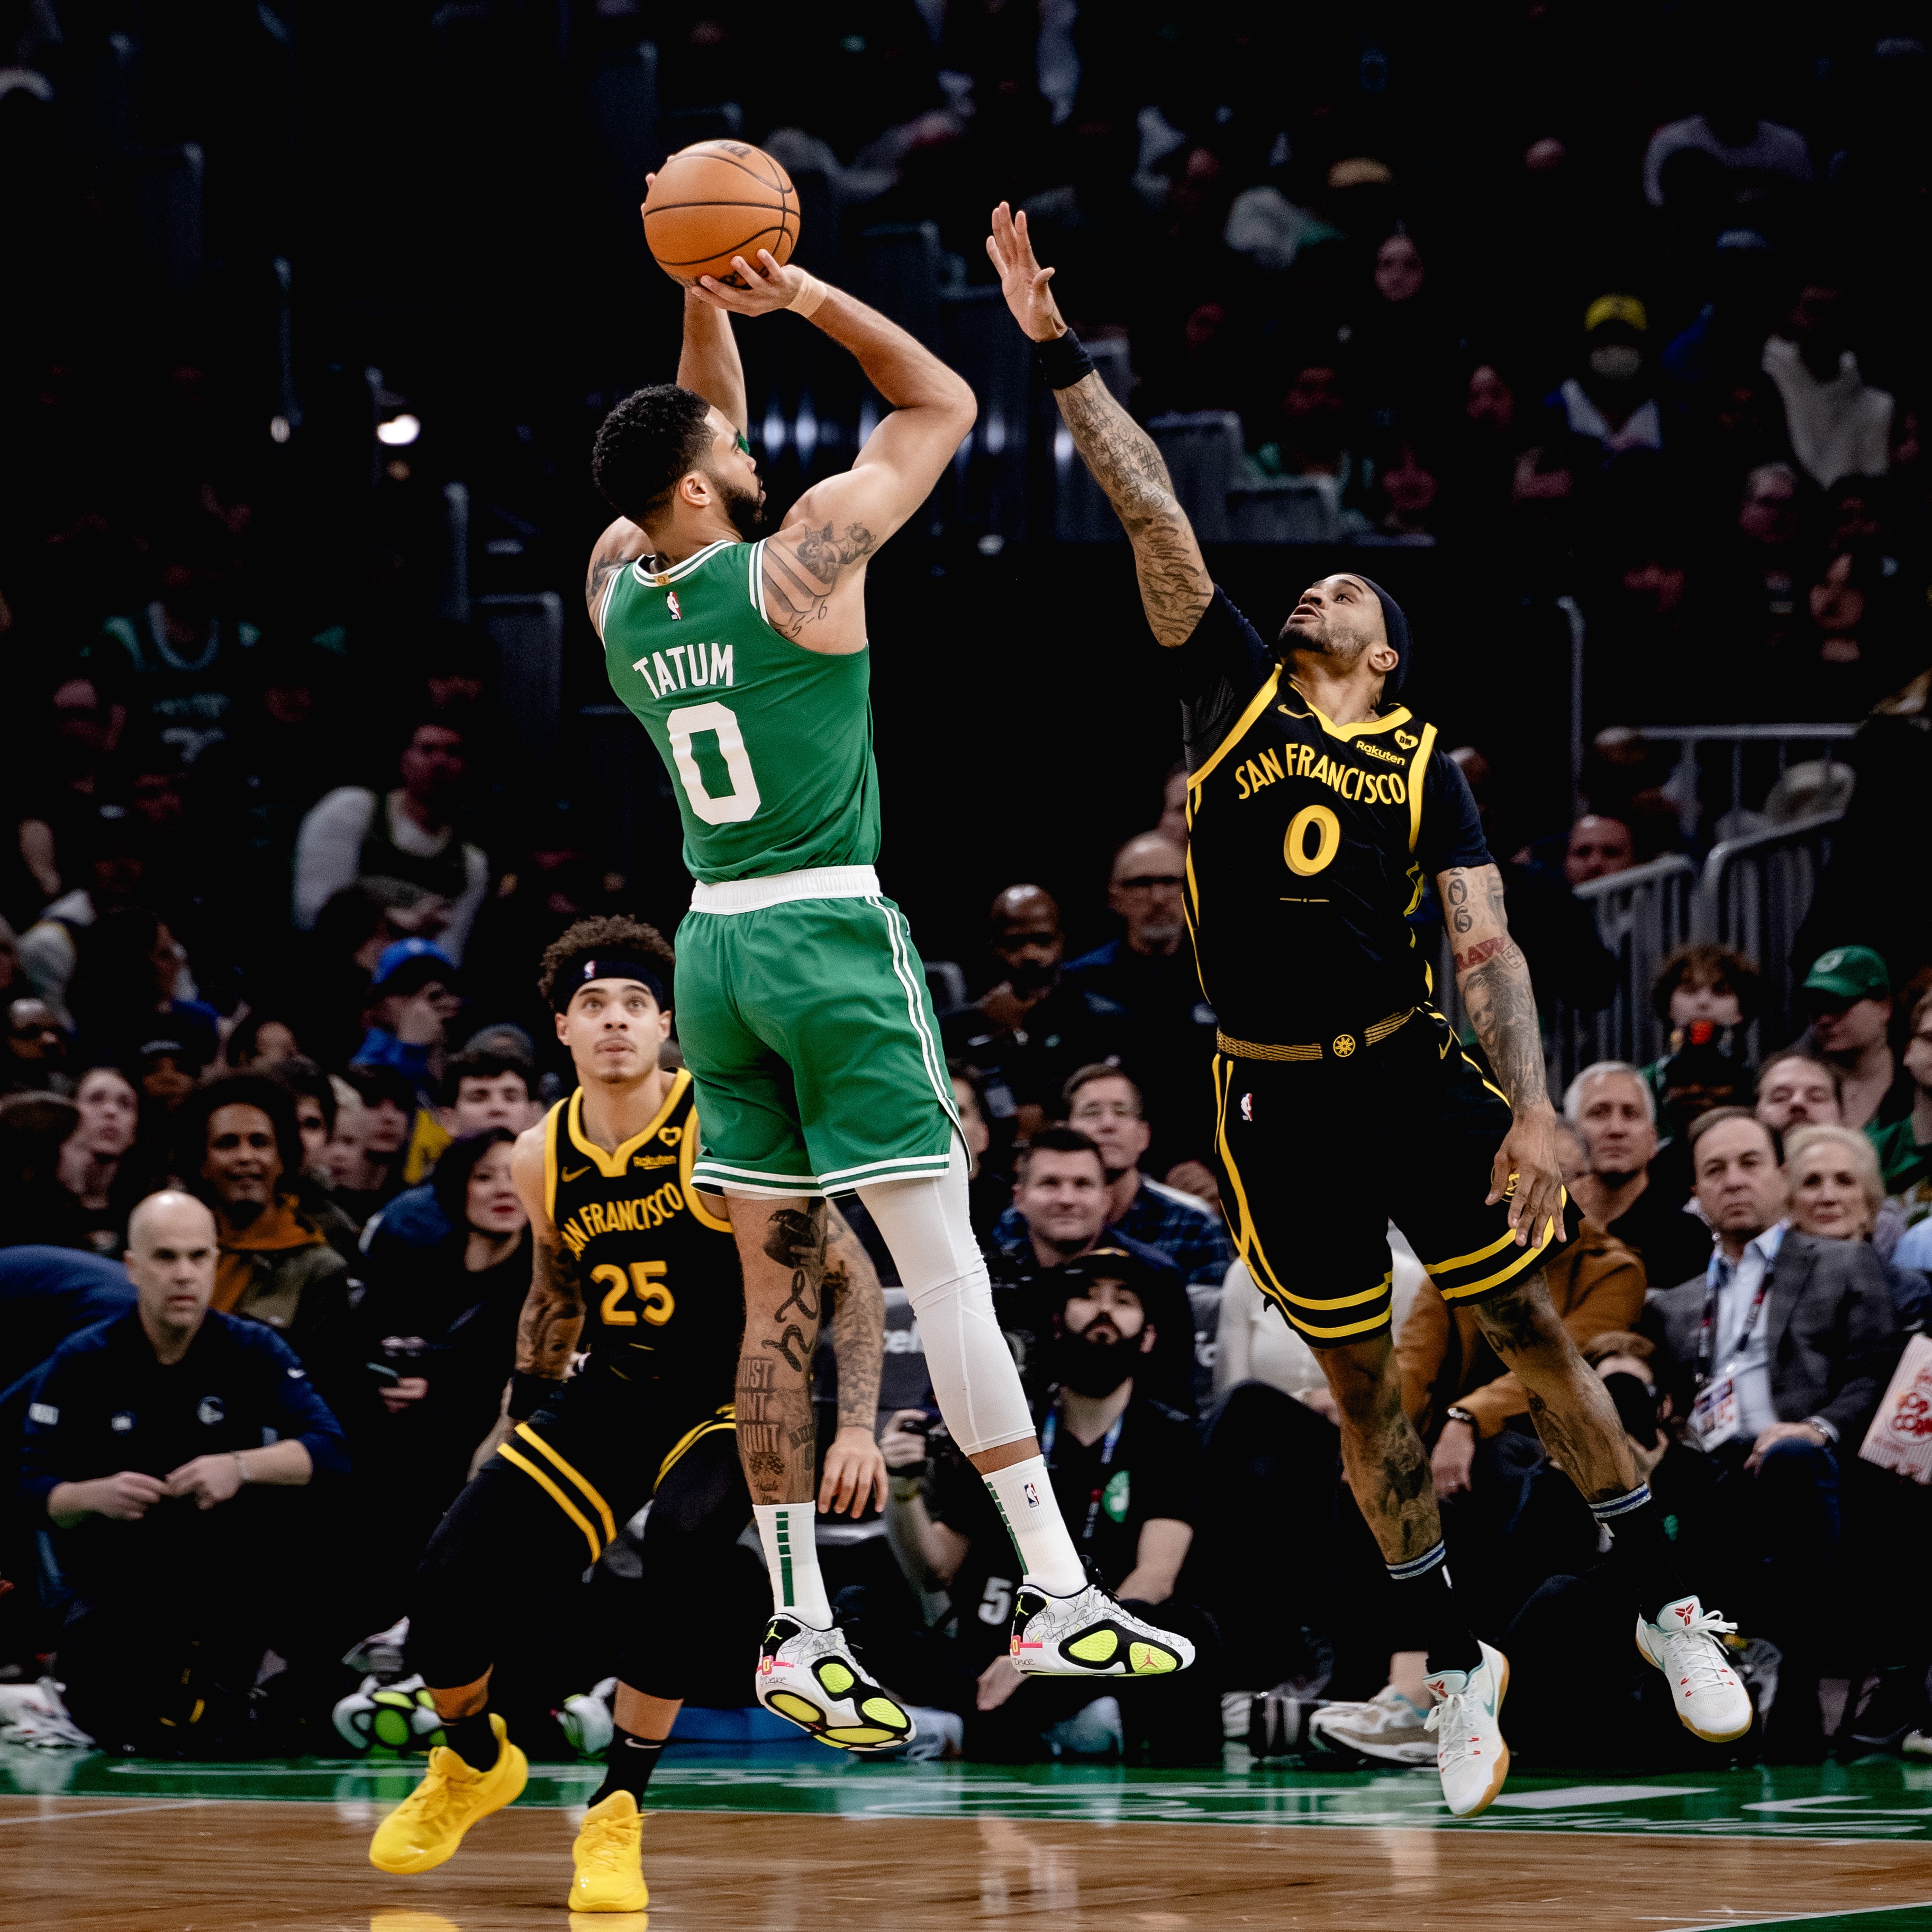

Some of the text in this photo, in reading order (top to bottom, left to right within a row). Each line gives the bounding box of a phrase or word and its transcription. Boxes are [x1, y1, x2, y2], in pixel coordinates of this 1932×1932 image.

[632, 643, 733, 699] TATUM
[666, 701, 761, 826] 0
[1235, 743, 1406, 804] SAN FRANCISCO
[1356, 740, 1405, 766] Rakuten
[1283, 804, 1340, 877] 0
[560, 1181, 685, 1262] AN FRANCISCO
[589, 1260, 676, 1326] 25
[977, 1576, 1013, 1626] 5
